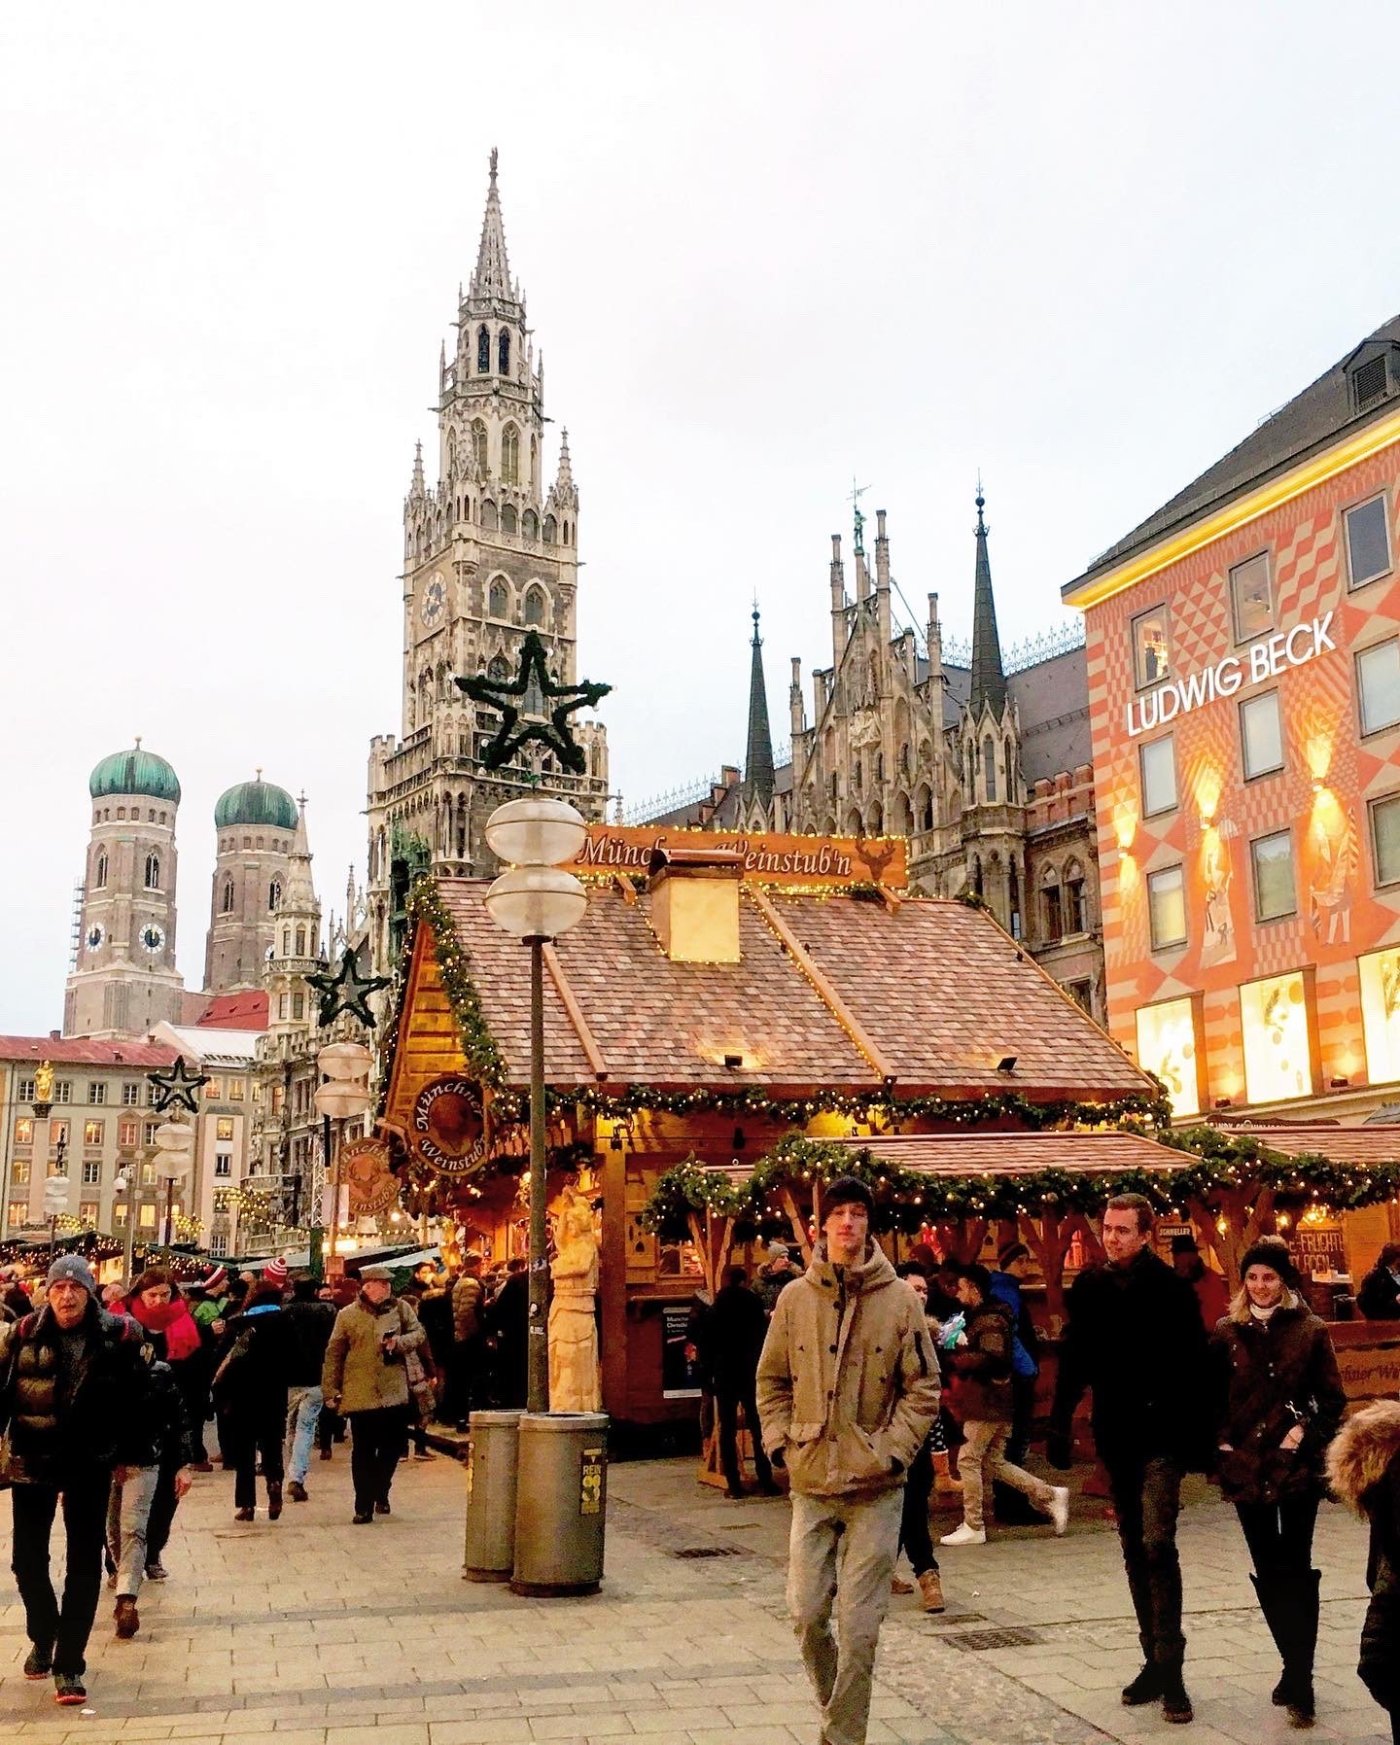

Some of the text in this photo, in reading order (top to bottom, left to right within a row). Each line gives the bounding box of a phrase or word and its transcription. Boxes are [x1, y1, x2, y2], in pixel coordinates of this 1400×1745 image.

[1127, 611, 1336, 737] LUDWIG BECK
[416, 1081, 484, 1131] Münchner
